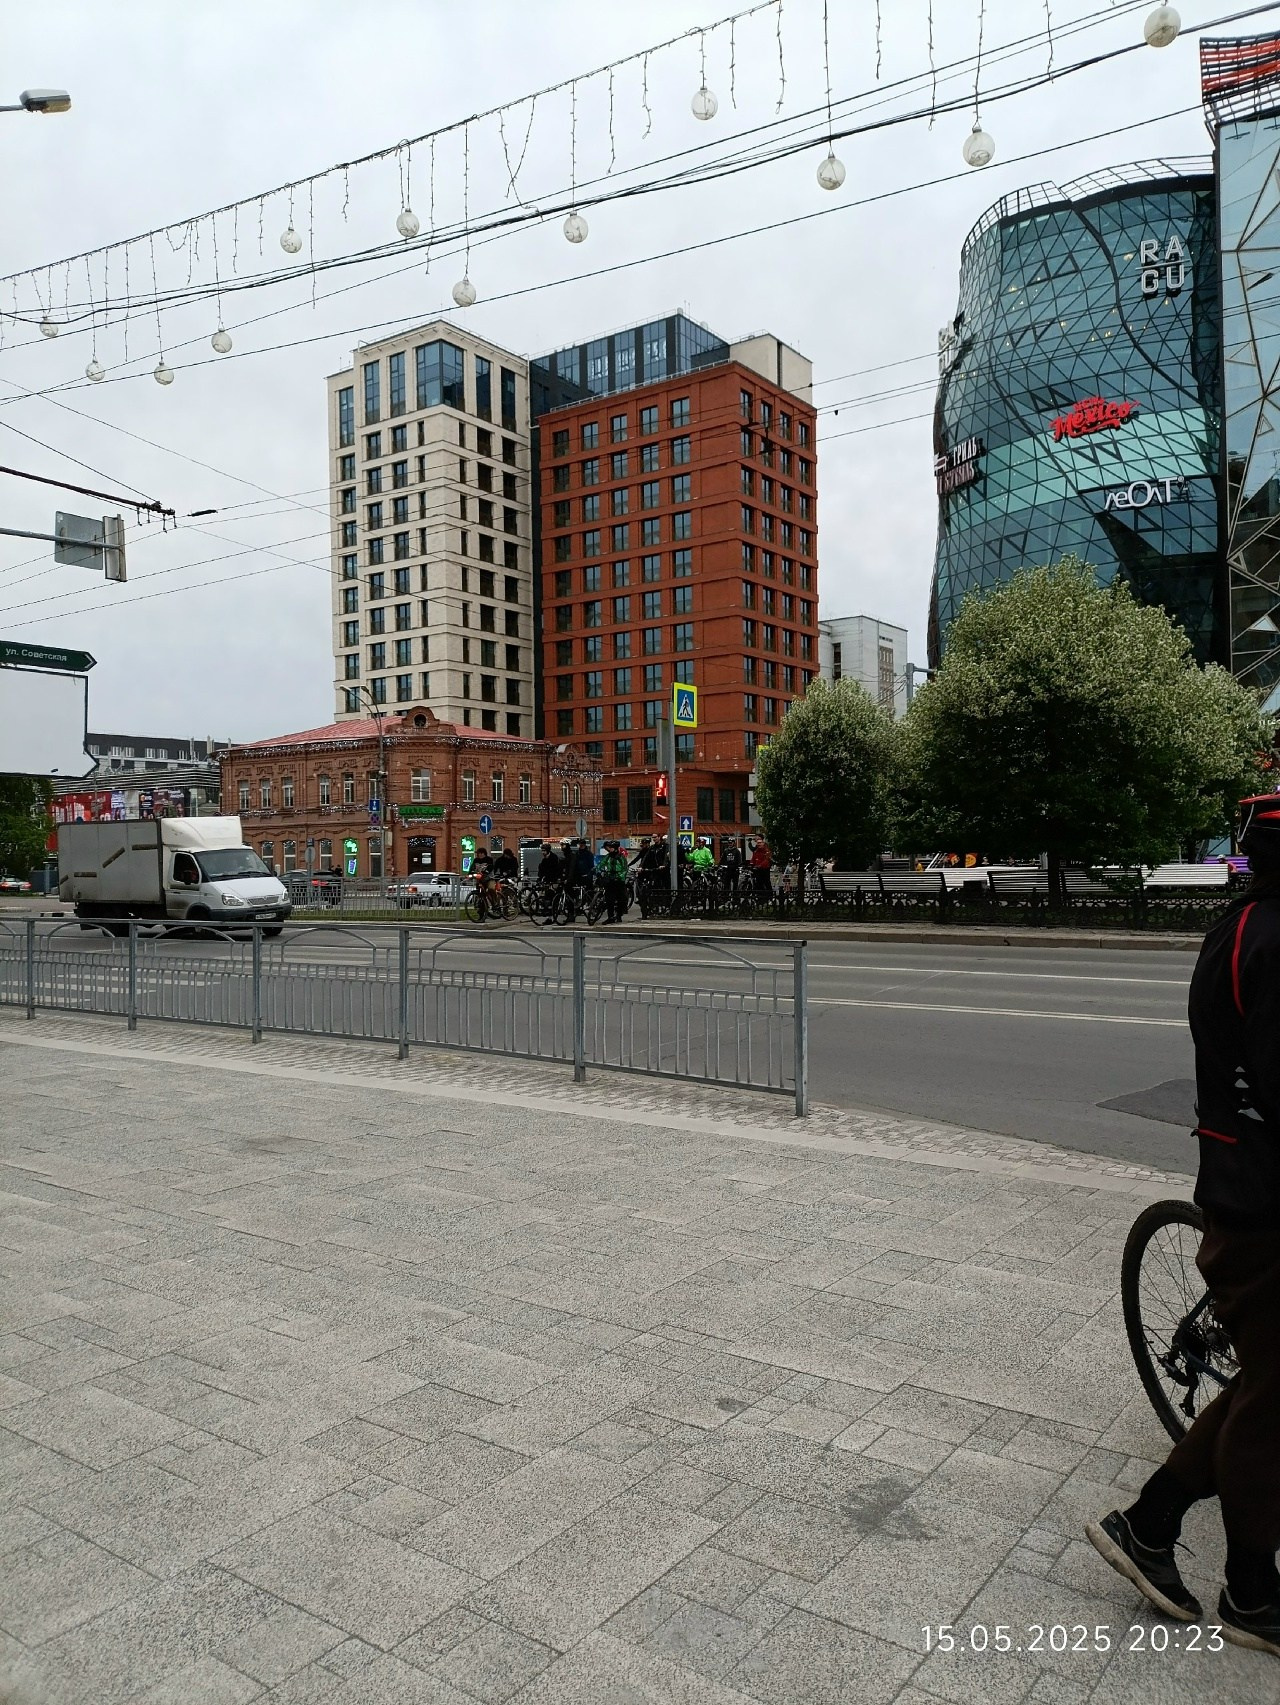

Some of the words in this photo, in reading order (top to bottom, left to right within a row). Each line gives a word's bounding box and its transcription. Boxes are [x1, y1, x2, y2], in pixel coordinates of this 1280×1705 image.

[1049, 401, 1140, 442] Mexico
[953, 436, 977, 467] ГРИЛЬ
[5, 647, 19, 656] ул.
[21, 649, 67, 662] Советская
[656, 787, 667, 797] 21
